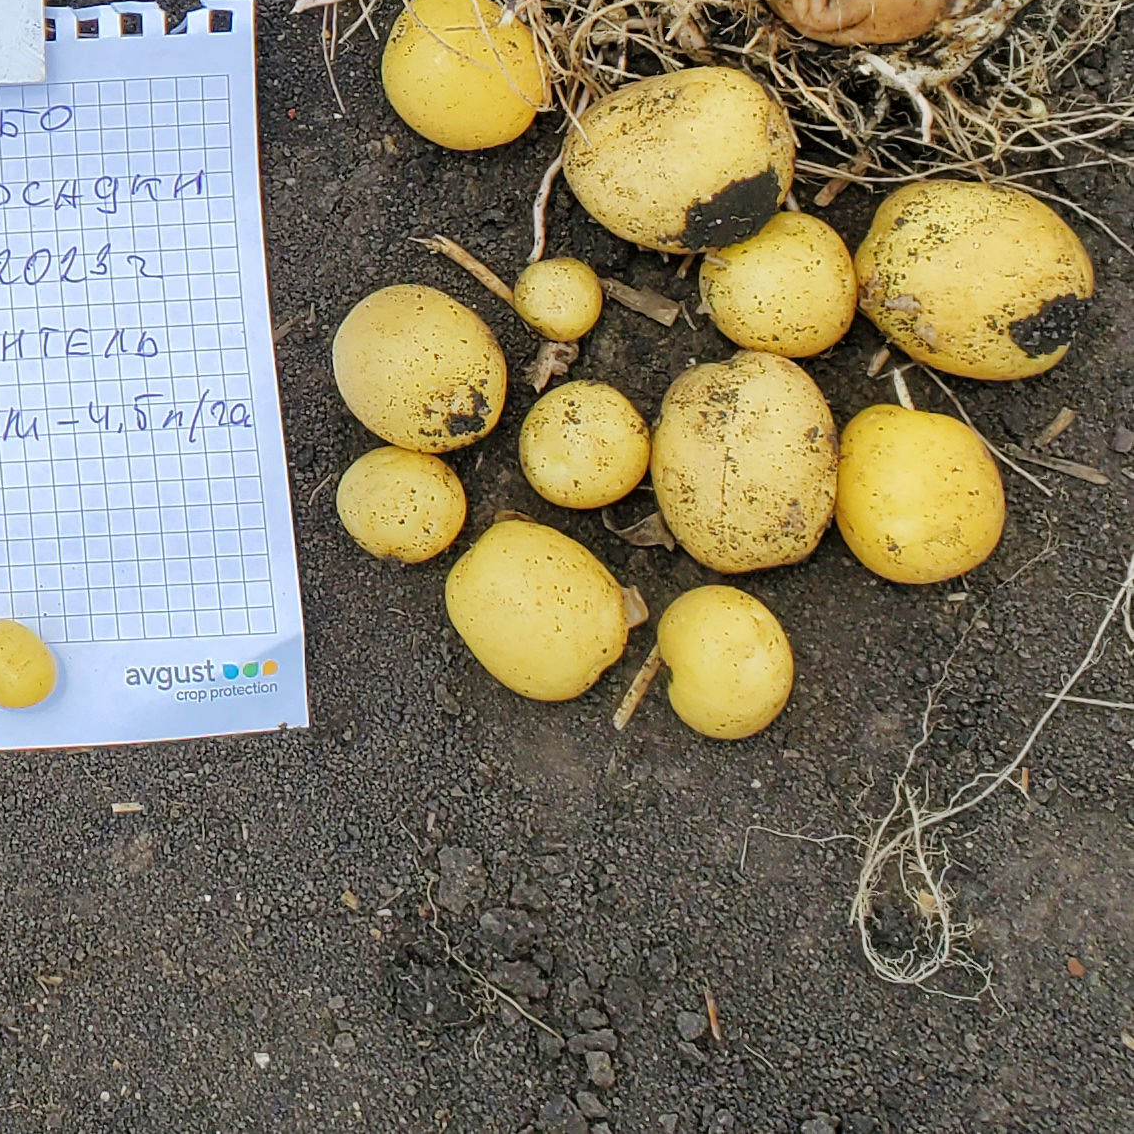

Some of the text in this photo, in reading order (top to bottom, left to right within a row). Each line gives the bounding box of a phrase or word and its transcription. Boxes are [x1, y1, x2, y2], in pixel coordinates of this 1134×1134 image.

[125, 659, 216, 691] avgust
[176, 681, 279, 703] crop protection
